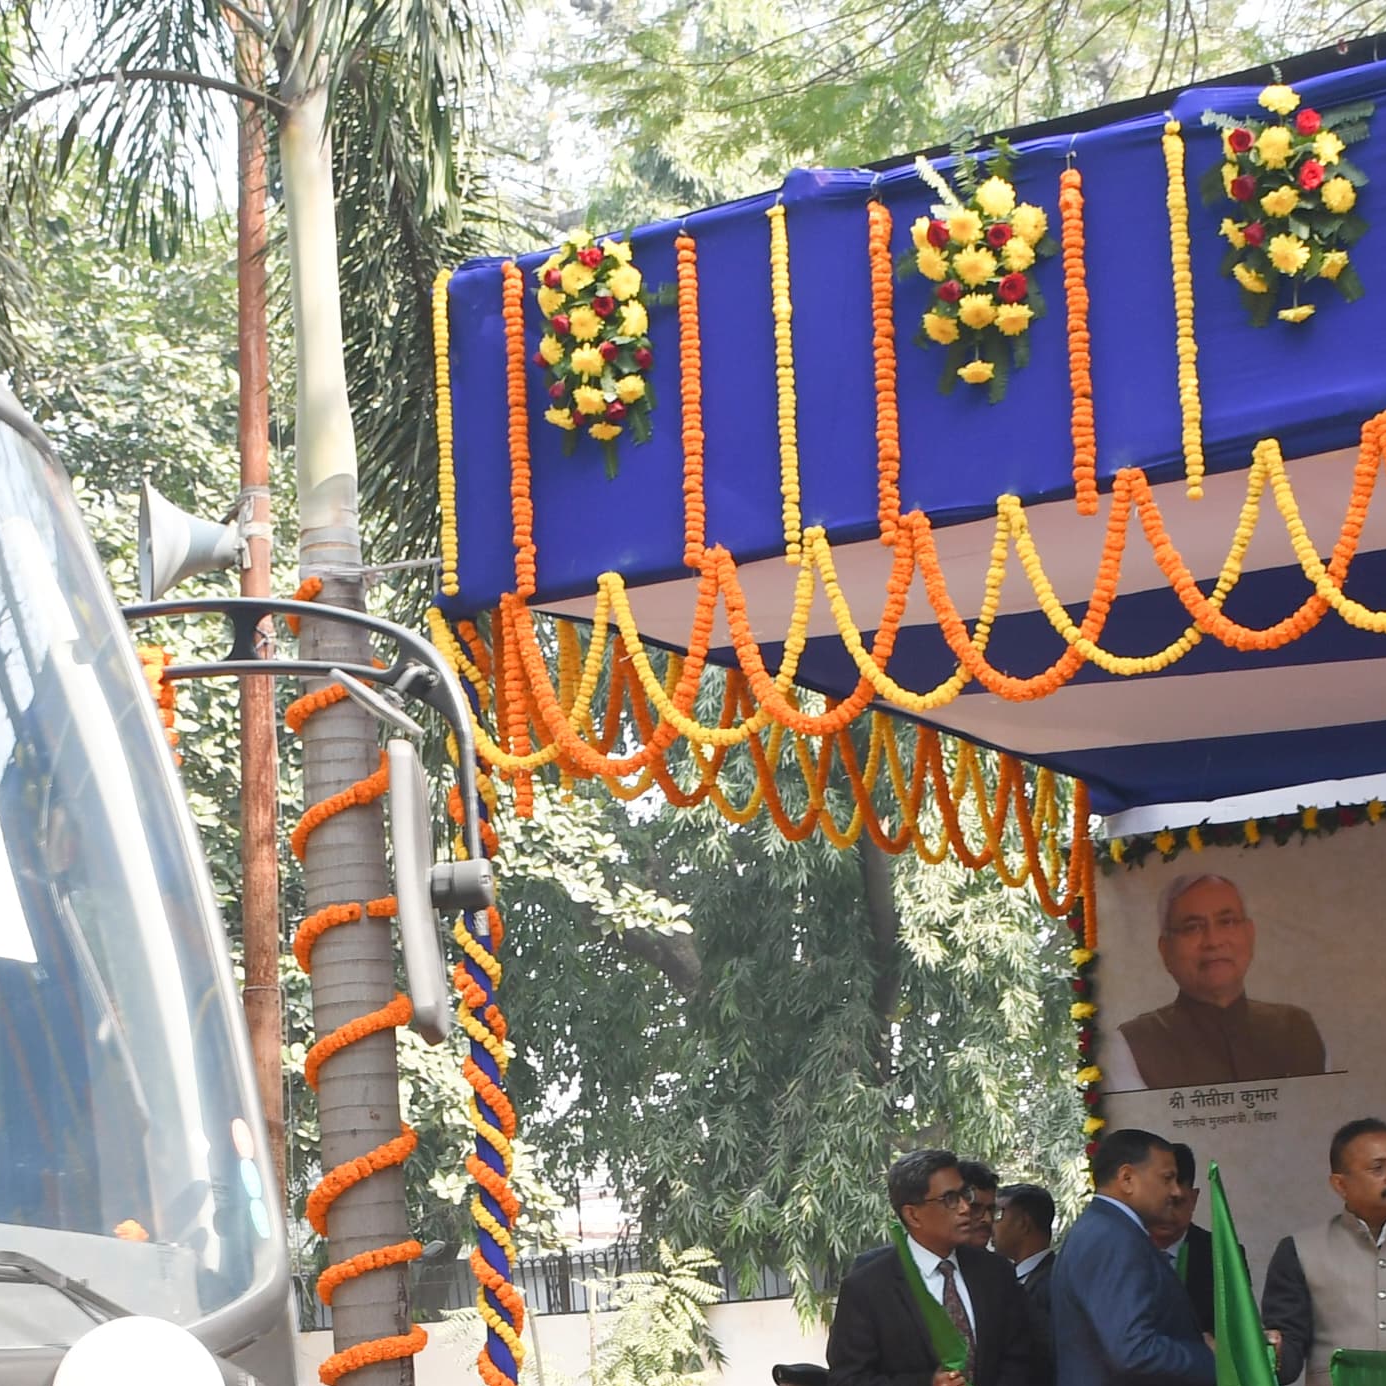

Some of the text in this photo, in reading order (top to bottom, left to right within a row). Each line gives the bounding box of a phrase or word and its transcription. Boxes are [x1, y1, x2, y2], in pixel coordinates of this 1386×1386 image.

[1168, 1088, 1280, 1109] श्री नीतीश कुमार
